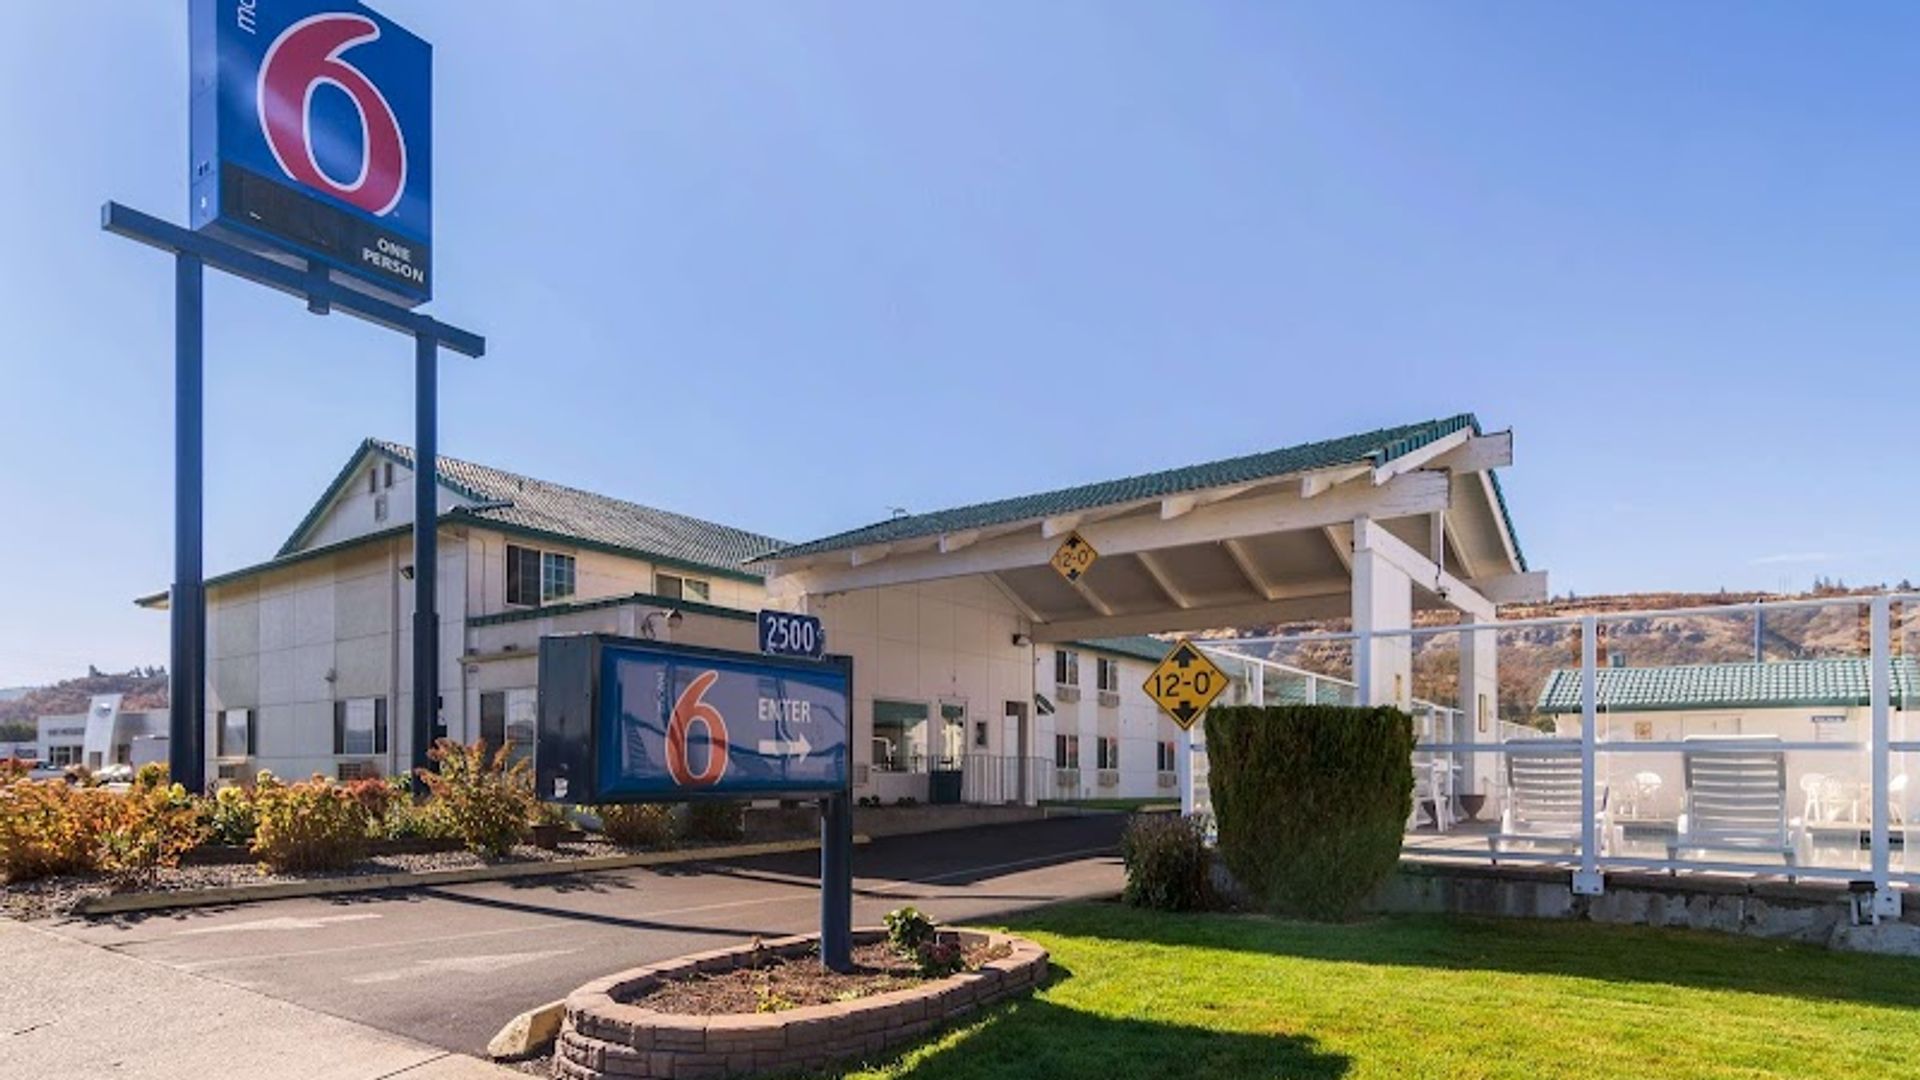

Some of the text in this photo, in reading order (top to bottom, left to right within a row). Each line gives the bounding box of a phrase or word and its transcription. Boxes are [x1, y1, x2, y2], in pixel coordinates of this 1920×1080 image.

[257, 12, 406, 217] 6
[362, 247, 424, 284] PERSON
[376, 237, 411, 262] ONE
[766, 616, 815, 653] 2500
[664, 669, 729, 786] 6
[758, 698, 811, 723] ENTER
